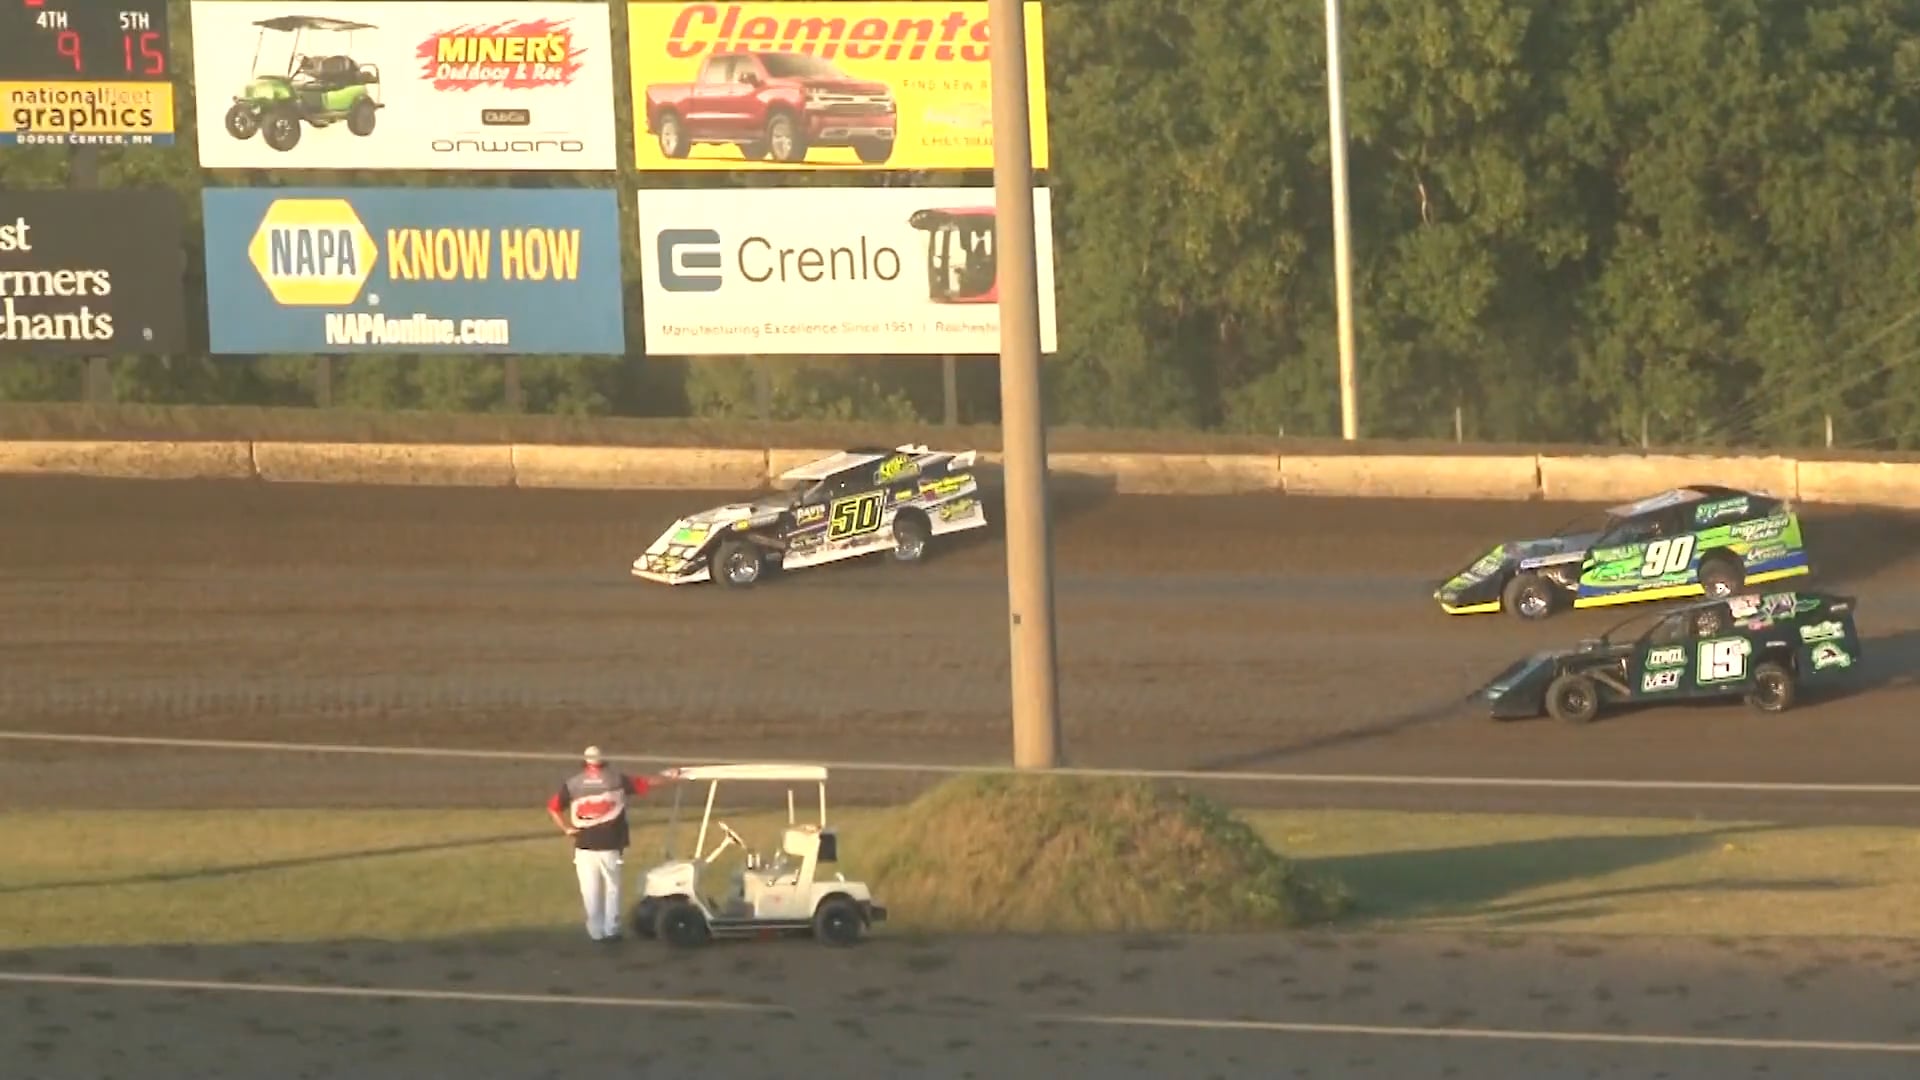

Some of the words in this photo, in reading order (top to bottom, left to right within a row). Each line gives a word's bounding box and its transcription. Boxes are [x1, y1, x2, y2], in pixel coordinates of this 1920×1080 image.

[36, 11, 68, 29] 4TH
[119, 11, 149, 30] 5TH
[665, 4, 990, 62] Clements
[58, 31, 81, 72] 9
[124, 32, 164, 74] 15
[437, 33, 566, 63] MINER'S
[436, 62, 510, 80] Outdoor
[903, 79, 936, 91] FIND
[13, 102, 153, 132] graphics
[17, 135, 64, 144] DODGE
[132, 135, 153, 144] MN
[270, 229, 356, 276] NAPA
[387, 228, 490, 280] KNOW
[501, 228, 580, 280] HOW
[737, 235, 901, 283] Crenlo
[325, 312, 509, 345] NAPAonline.com
[662, 324, 760, 338] Manufacturing
[764, 322, 838, 335] Excellence
[1641, 536, 1694, 577] 90
